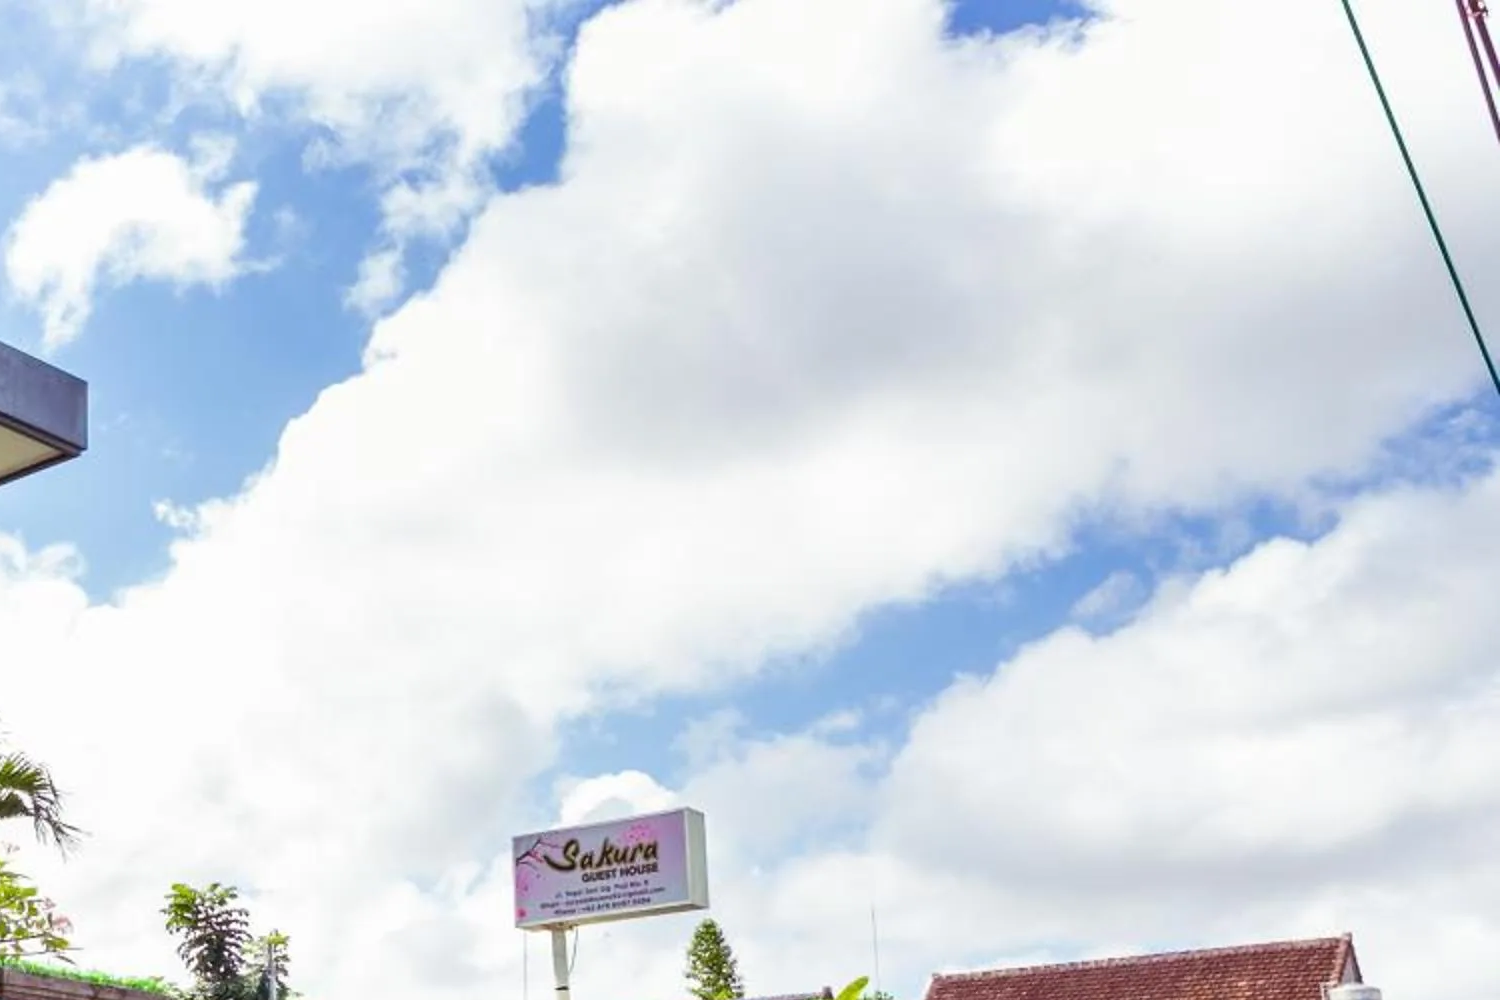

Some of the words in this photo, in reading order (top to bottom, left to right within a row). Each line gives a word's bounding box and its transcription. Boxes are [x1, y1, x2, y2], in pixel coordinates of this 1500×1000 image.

[543, 836, 659, 872] Sakura
[581, 868, 617, 883] GUEST
[619, 861, 659, 878] HOUSE
